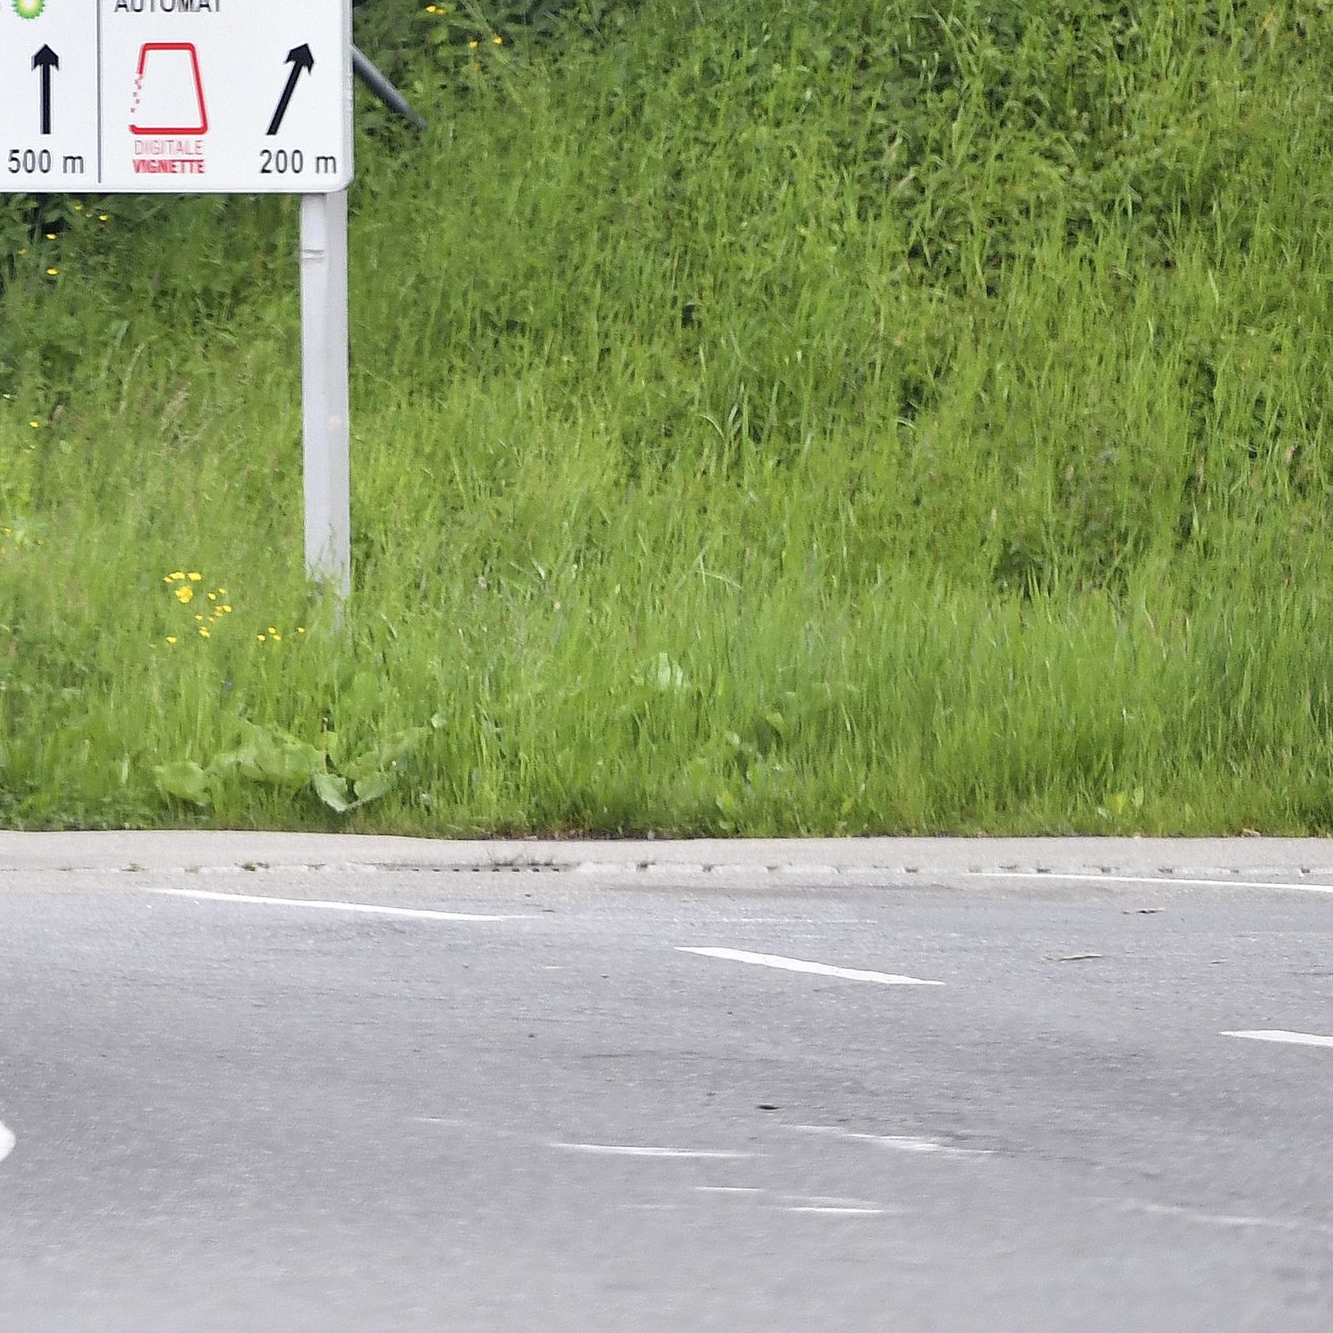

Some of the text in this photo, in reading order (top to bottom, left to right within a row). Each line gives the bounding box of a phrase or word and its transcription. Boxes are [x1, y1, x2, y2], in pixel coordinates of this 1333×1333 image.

[134, 139, 203, 155] DIGITALE
[8, 149, 84, 174] 500 m
[132, 159, 204, 174] VIGNETTE
[260, 149, 337, 174] 200 m
